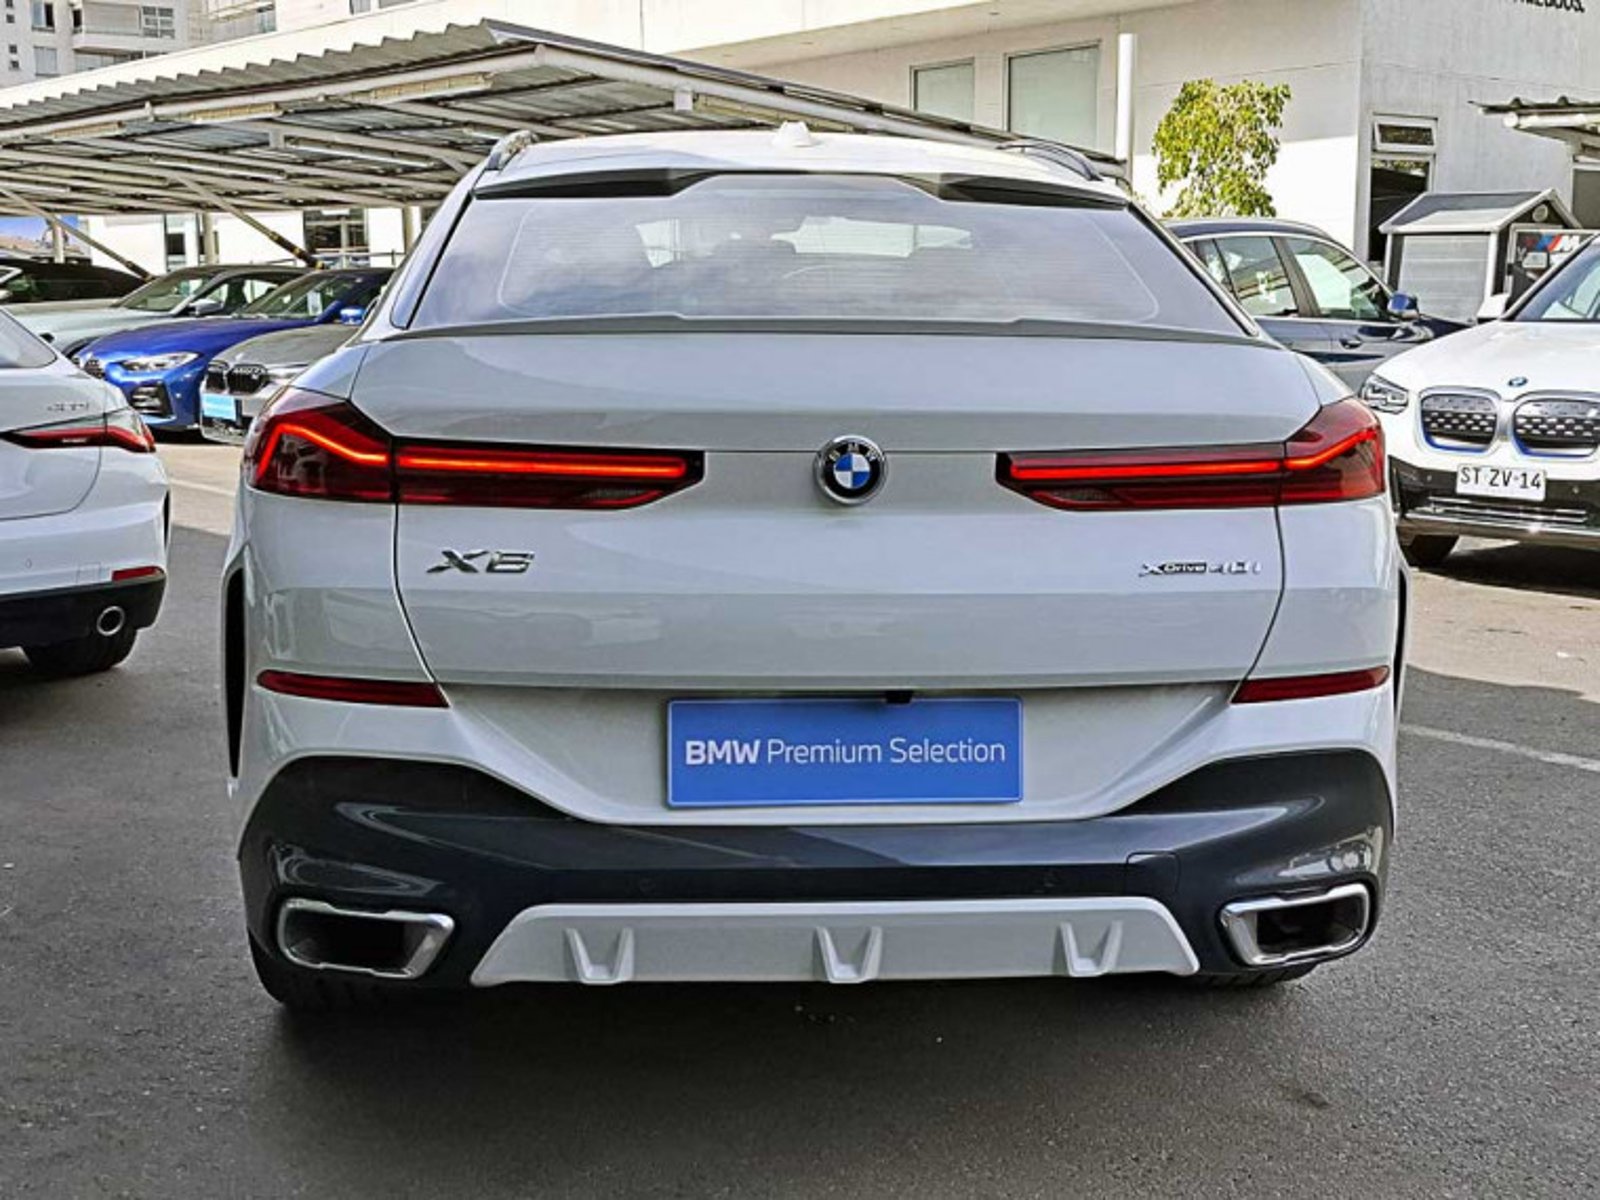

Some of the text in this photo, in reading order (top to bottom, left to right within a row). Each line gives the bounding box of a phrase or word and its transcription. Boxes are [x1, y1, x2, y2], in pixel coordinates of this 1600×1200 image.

[1460, 466, 1481, 485] ST
[426, 549, 535, 573] X6
[685, 736, 1006, 765] BMW Premium Selection
